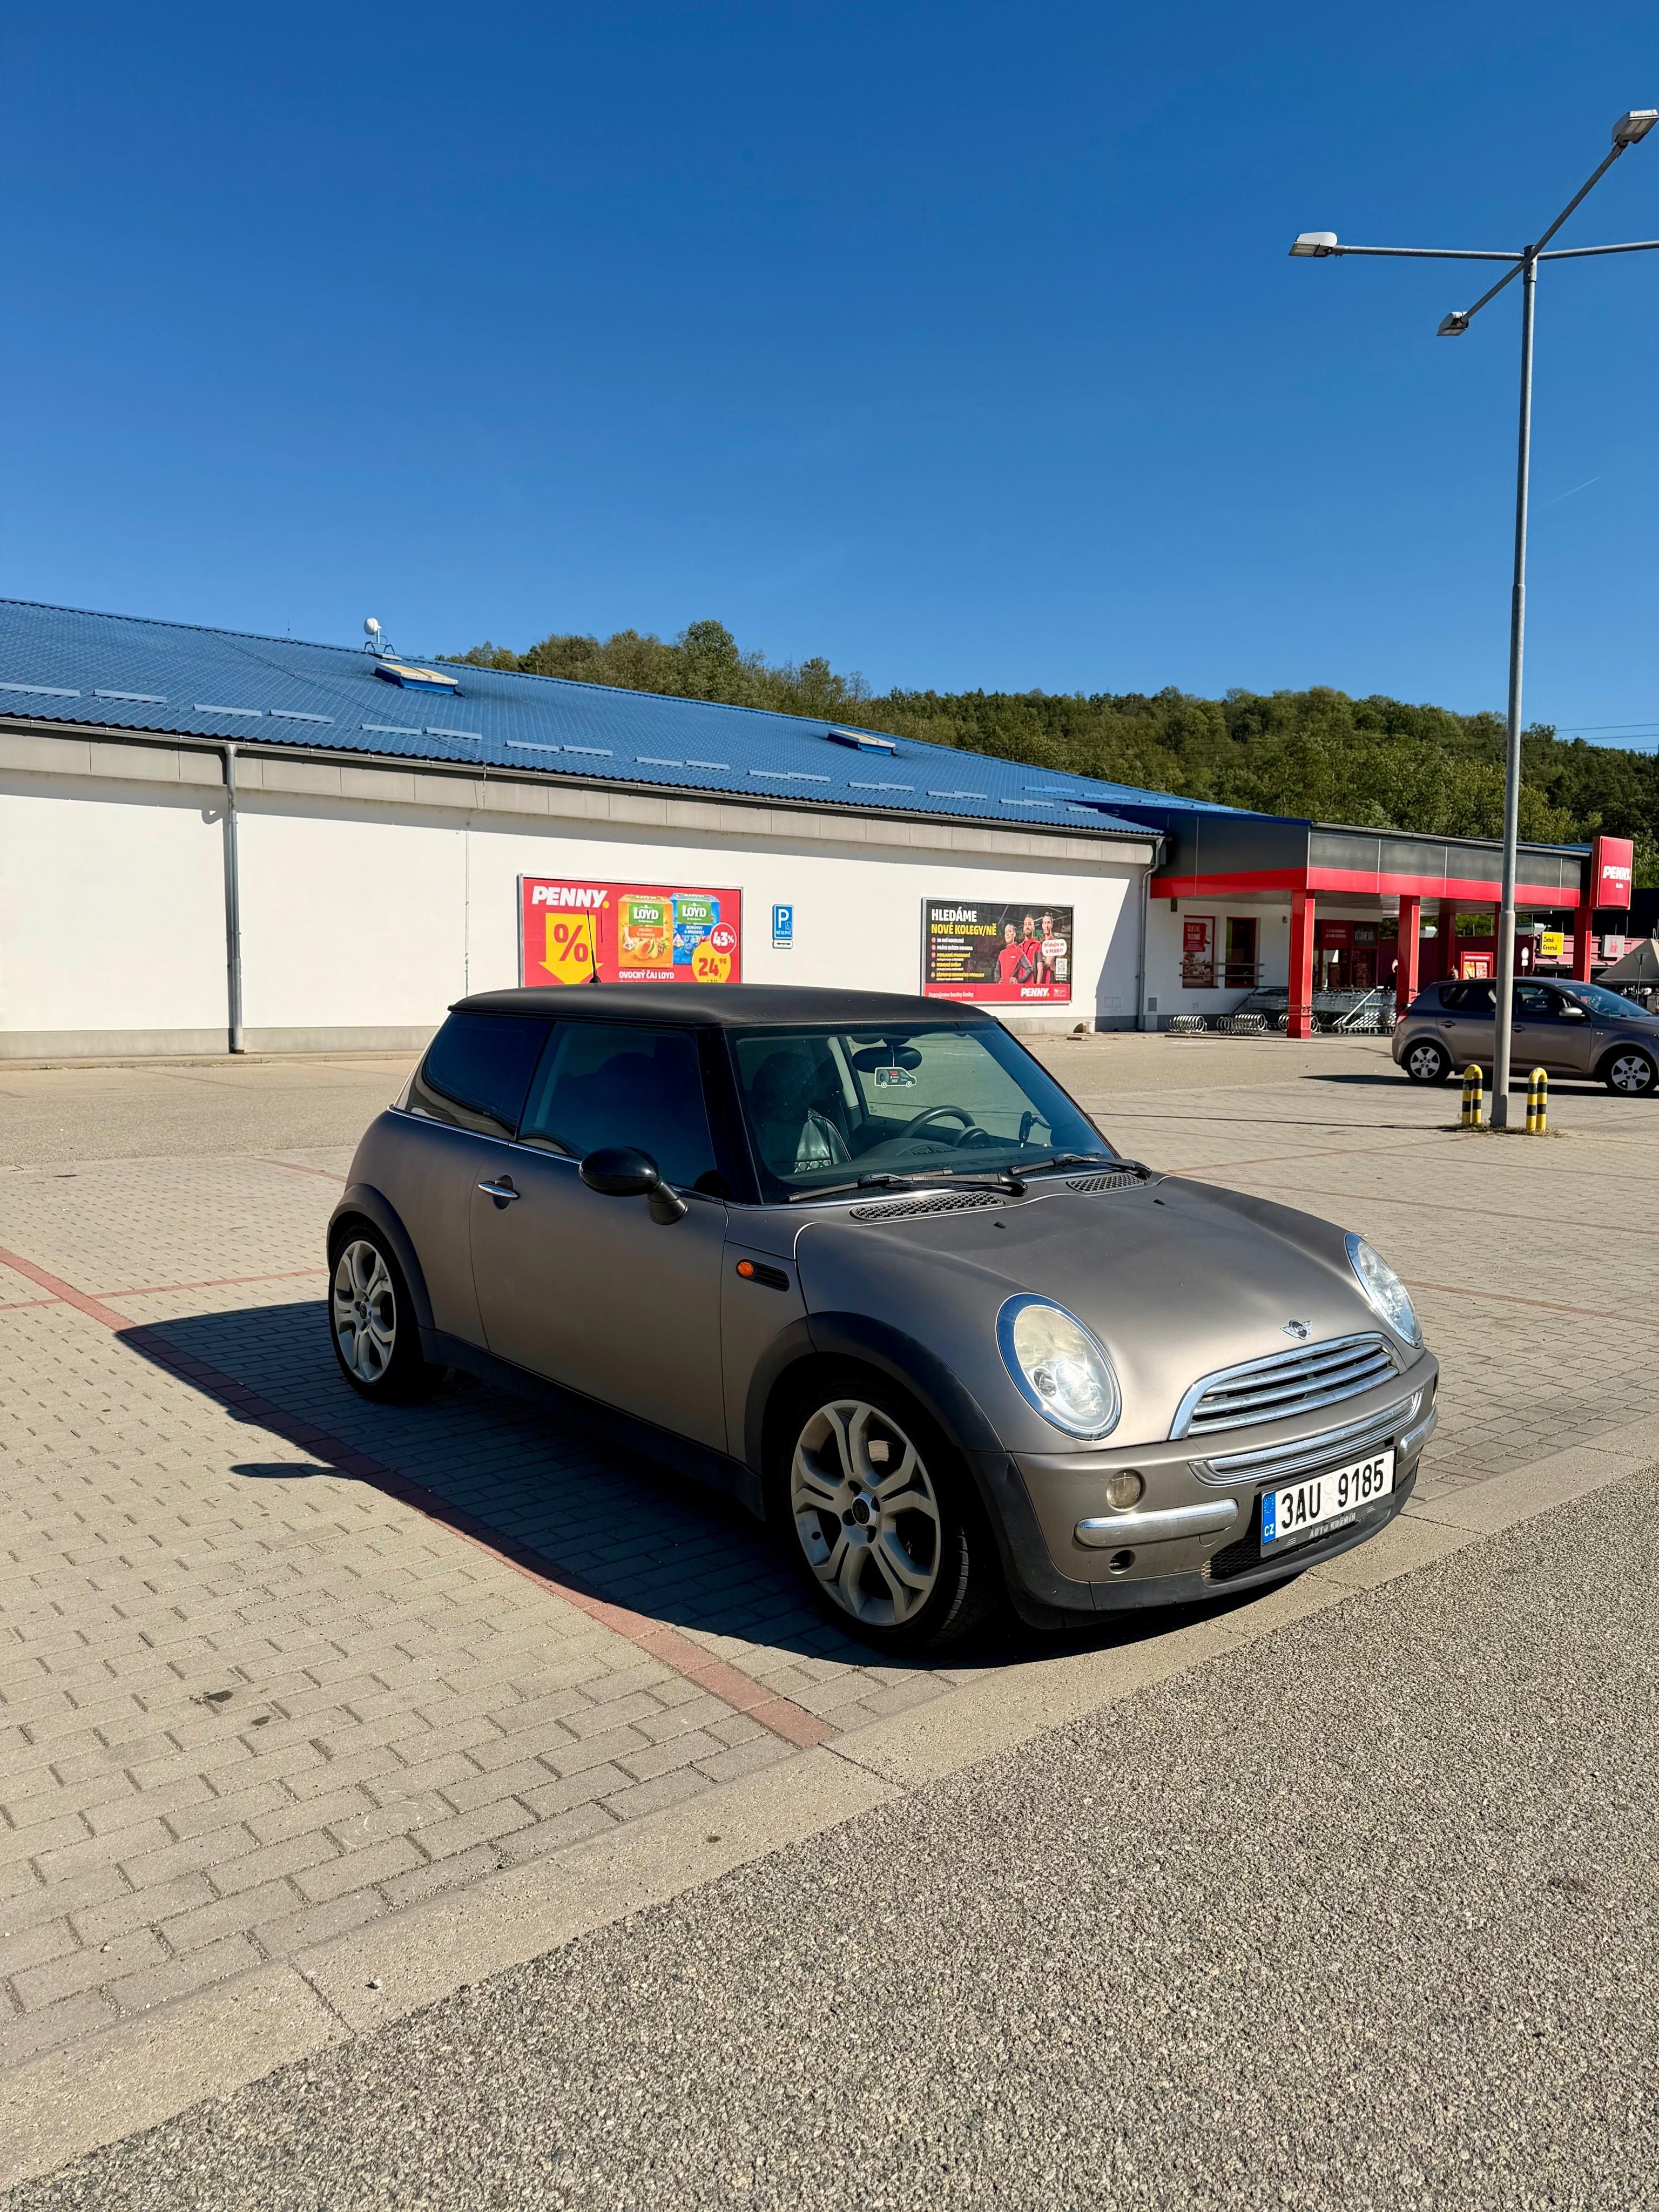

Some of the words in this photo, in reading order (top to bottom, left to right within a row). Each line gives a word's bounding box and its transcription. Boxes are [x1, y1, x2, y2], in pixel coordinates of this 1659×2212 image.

[633, 907, 659, 920] LOYD
[682, 905, 707, 918] LOYD
[778, 908, 790, 928] P
[932, 906, 977, 922] HLEDÁME
[931, 921, 954, 934] NOVÉ
[954, 923, 997, 936] KOLEGY/NĚ
[619, 969, 645, 979] OVOCNÝ
[646, 969, 658, 979] ČAJ
[1264, 1523, 1274, 1537] CZ
[1281, 1482, 1321, 1529] 3AU
[1338, 1458, 1384, 1508] 9185
[1309, 1523, 1328, 1539] AUTO
